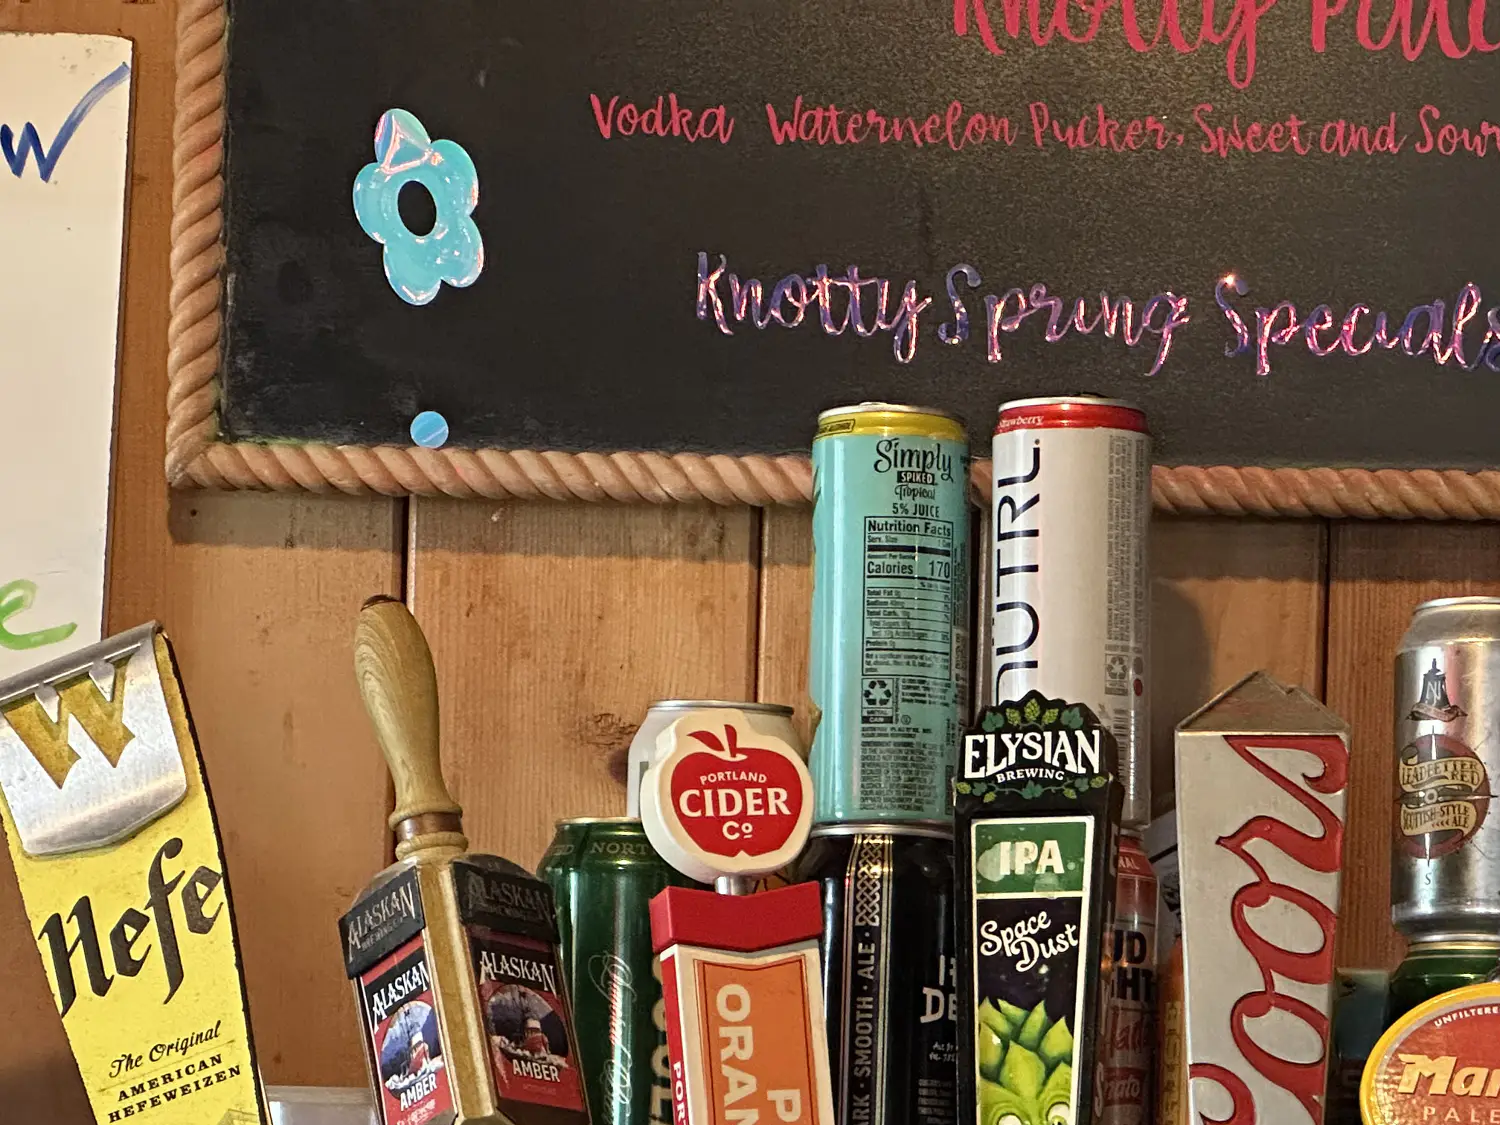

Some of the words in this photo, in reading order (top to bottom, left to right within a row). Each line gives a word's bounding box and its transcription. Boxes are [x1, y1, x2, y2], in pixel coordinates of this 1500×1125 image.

[590, 93, 735, 144] Vodka
[765, 94, 1019, 151] Watermelon
[1194, 104, 1311, 158] Sweet
[1321, 111, 1407, 157] and
[695, 252, 932, 363] Knotty
[938, 263, 1191, 376] Spring
[873, 437, 954, 483] Simply
[900, 472, 934, 484] SPIKED
[892, 503, 909, 515] 5%
[912, 503, 940, 518] JUICE
[894, 484, 936, 501] Tropical
[867, 520, 920, 532] Nutrition
[924, 521, 951, 536] Facts
[867, 561, 914, 574] Calories
[928, 560, 951, 578] 170
[963, 729, 1101, 779] ELYSIAN
[1402, 759, 1478, 786] LEADBETTER
[699, 770, 768, 786] PORTLAND
[996, 768, 1065, 784] BREWING
[1451, 769, 1481, 787] RED
[678, 786, 792, 818] CIDER
[1451, 816, 1470, 829] ALE
[999, 840, 1065, 876] IPA
[347, 882, 417, 954] ALASKAN
[980, 911, 1051, 957] Space
[856, 941, 877, 982] ALE
[1010, 923, 1079, 973] Dust
[478, 950, 557, 994] ALASKAN
[371, 961, 430, 1032] ALASKAN
[108, 1052, 144, 1079] The
[148, 1020, 223, 1065] Original
[853, 994, 875, 1078] SMOOTH
[116, 1053, 224, 1101] AMERICAN
[512, 1058, 562, 1084] AMBER
[107, 1064, 243, 1124] HEFEWEIZEN
[399, 1076, 438, 1112] AMBER
